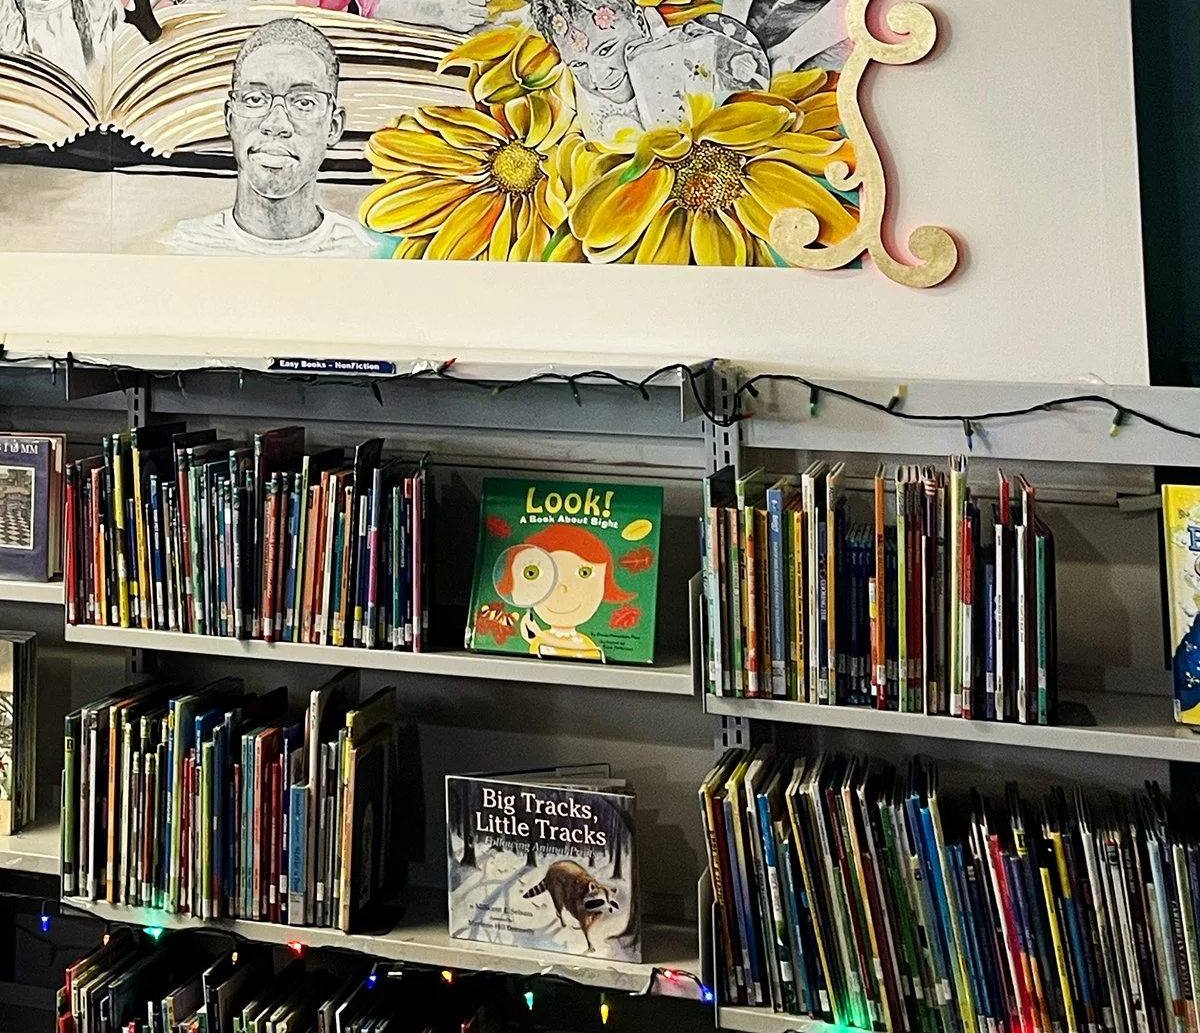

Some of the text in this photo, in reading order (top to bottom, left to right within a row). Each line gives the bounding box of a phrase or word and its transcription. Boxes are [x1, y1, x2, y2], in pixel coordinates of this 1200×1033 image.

[279, 359, 299, 369] Easy
[300, 359, 327, 368] Books
[21, 443, 39, 455] MM
[526, 486, 615, 518] Look!
[520, 515, 619, 529] A Book About Sight
[482, 788, 598, 824] Big Tracks,
[475, 811, 607, 846] Little Tracks
[484, 836, 531, 852] Following
[532, 842, 568, 856] Animal
